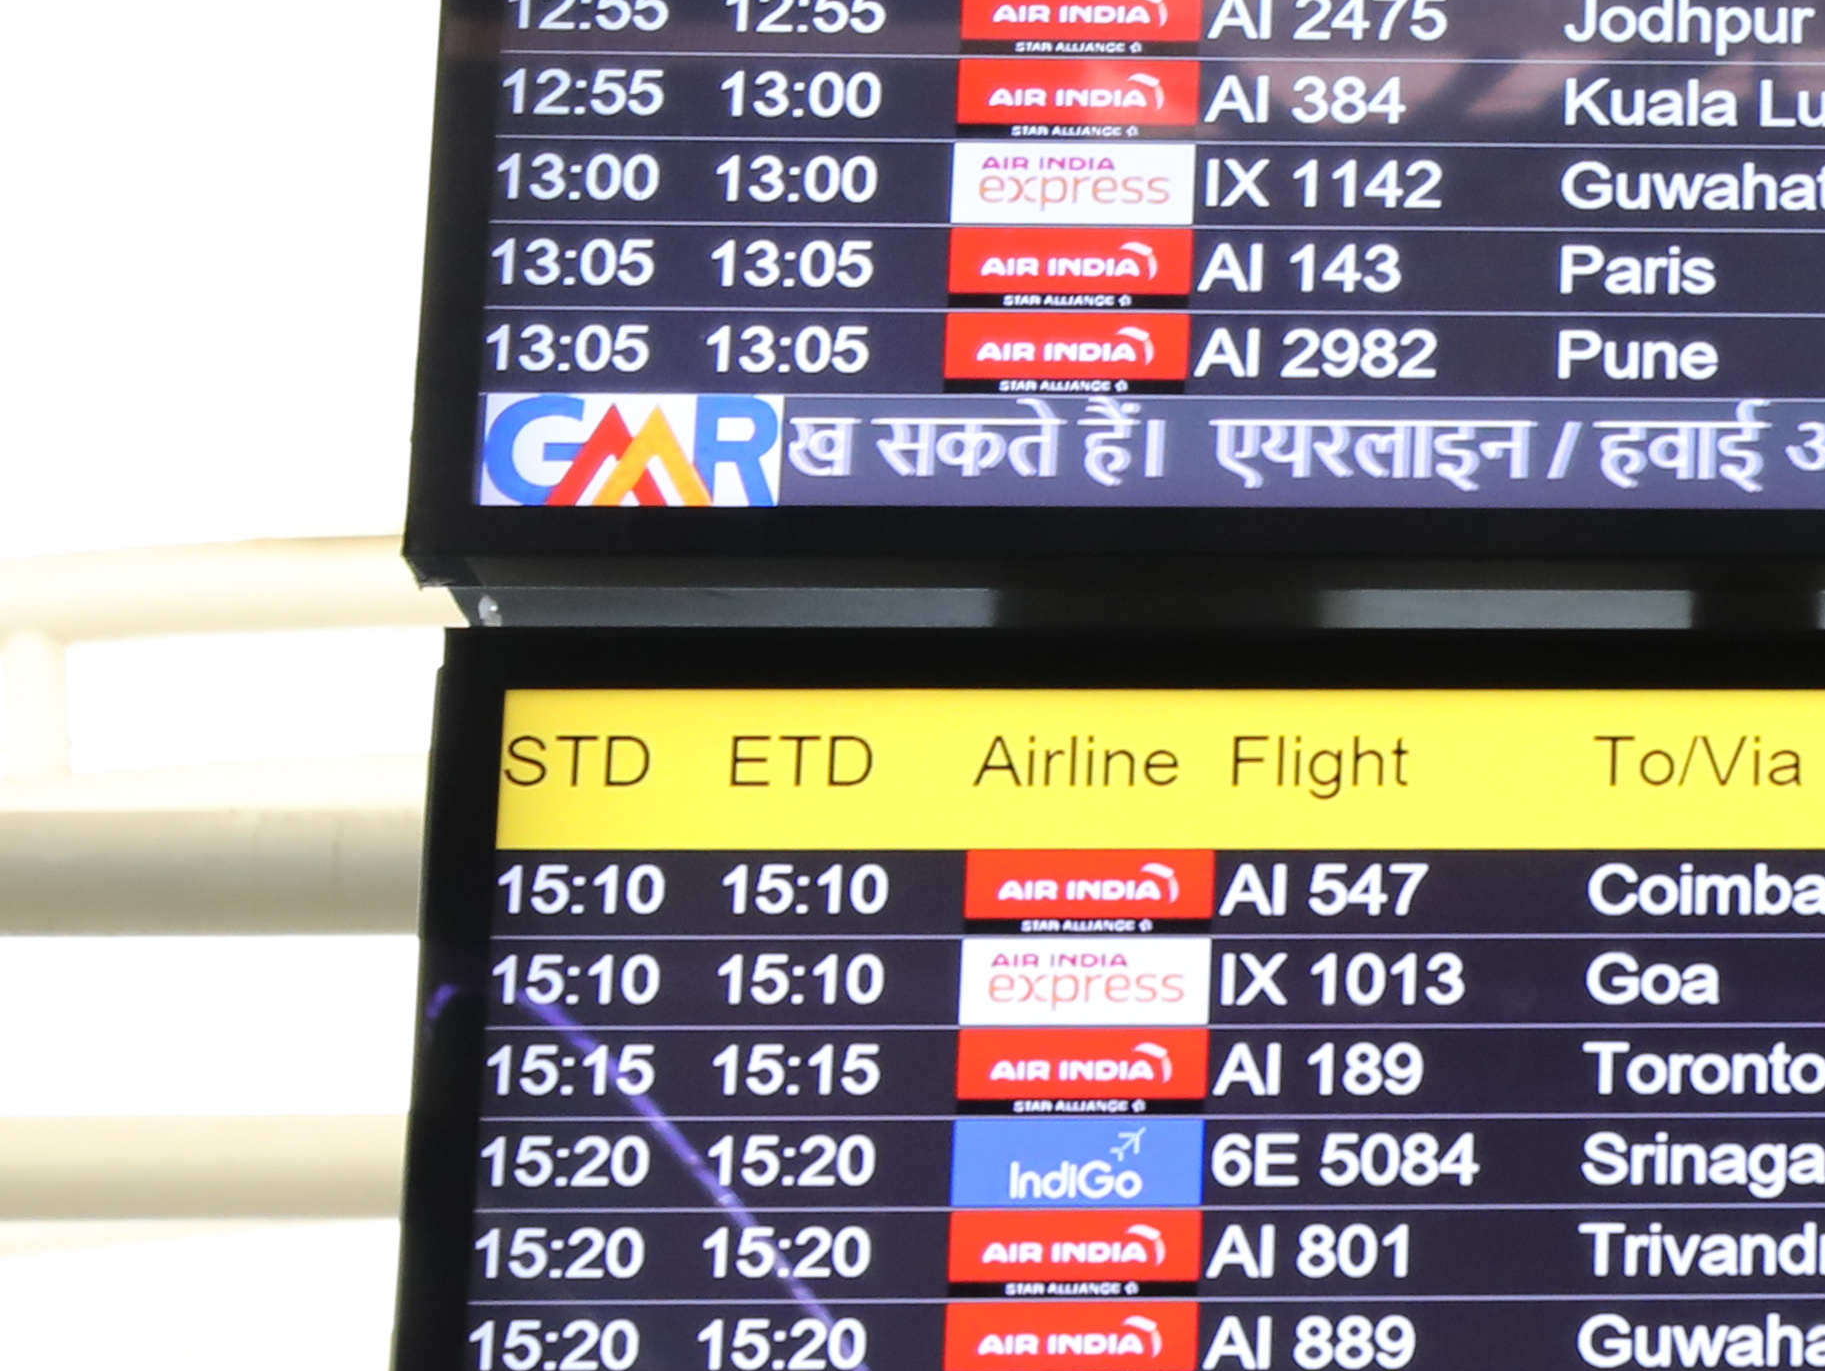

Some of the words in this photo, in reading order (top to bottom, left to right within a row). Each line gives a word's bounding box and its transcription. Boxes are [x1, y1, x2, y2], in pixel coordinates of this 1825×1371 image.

[982, 157, 1029, 169] AIR
[1040, 157, 1115, 170] INDIA
[1206, 158, 1269, 207] IX
[1293, 159, 1442, 208] 1142
[979, 176, 1169, 211] express
[481, 393, 780, 507] GMR
[876, 398, 1062, 479] सकते
[1209, 419, 1537, 489] एयरलाइन
[1594, 399, 1771, 492] हवाई
[504, 736, 651, 788] STD
[730, 736, 872, 786] ETD
[973, 735, 1178, 787] Airline
[1232, 735, 1408, 800] Flight
[1594, 735, 1801, 786] To/Via
[499, 864, 665, 914] 15:10
[723, 864, 888, 914] 15:10
[1219, 864, 1287, 915] AI
[1309, 863, 1429, 915] 547
[482, 1136, 649, 1186] 15:20
[700, 1135, 875, 1192] 15:20
[1212, 1133, 1299, 1186] 6E
[1320, 1133, 1479, 1186] 5084
[1010, 1160, 1142, 1199] IndiGo
